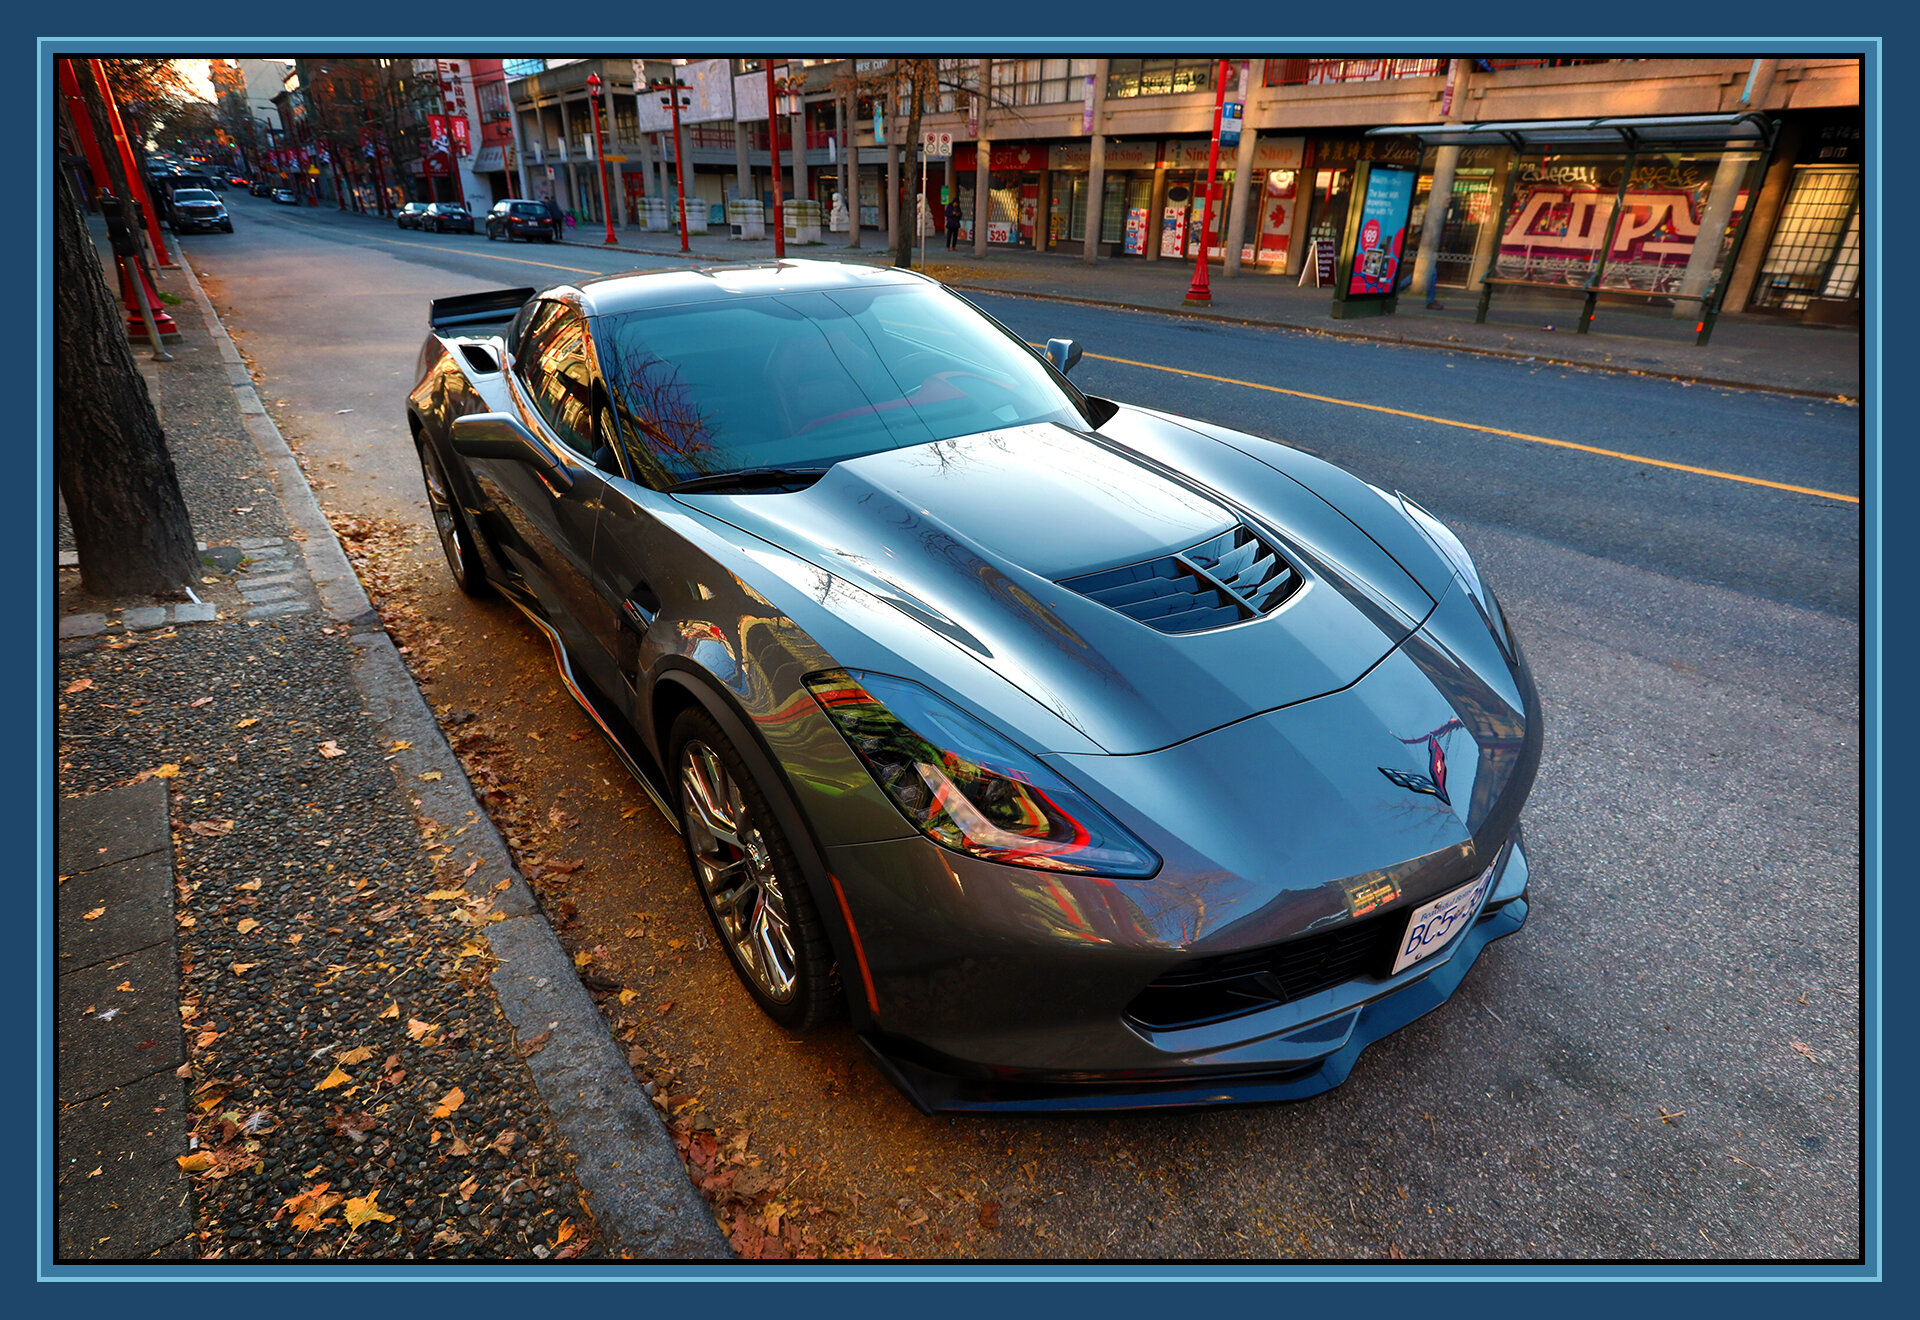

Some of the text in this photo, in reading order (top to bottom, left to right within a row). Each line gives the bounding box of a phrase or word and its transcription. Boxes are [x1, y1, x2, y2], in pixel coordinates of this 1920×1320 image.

[1120, 148, 1143, 162] Shop
[1259, 144, 1295, 165] Shop
[989, 230, 1008, 242] $20
